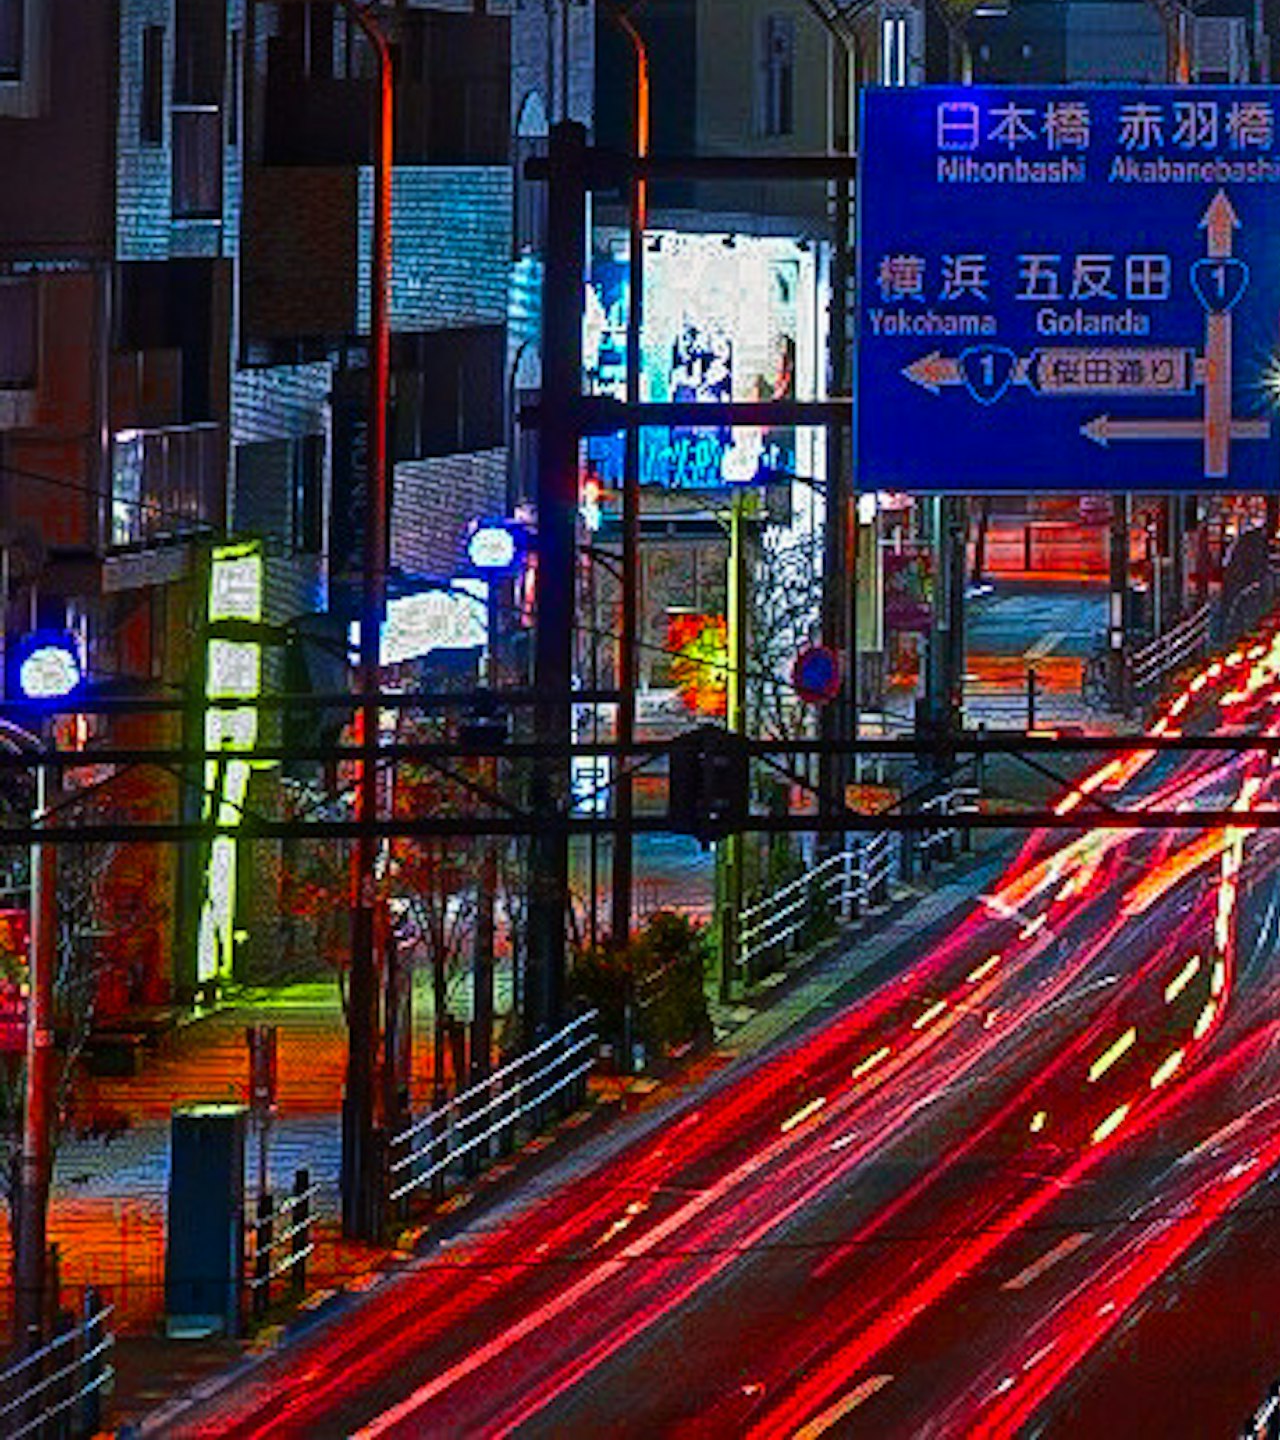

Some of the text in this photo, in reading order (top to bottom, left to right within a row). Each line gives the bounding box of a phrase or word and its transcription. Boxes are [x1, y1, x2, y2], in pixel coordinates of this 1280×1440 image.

[937, 102, 1274, 151] 日本橋 赤羽橋
[937, 155, 1280, 183] Nihonbashi Akabanebashi
[877, 254, 1171, 303] 横浜 五反田
[1211, 266, 1225, 298] 1
[868, 309, 1150, 336] Yokohama Gotanda
[979, 354, 994, 385] 1
